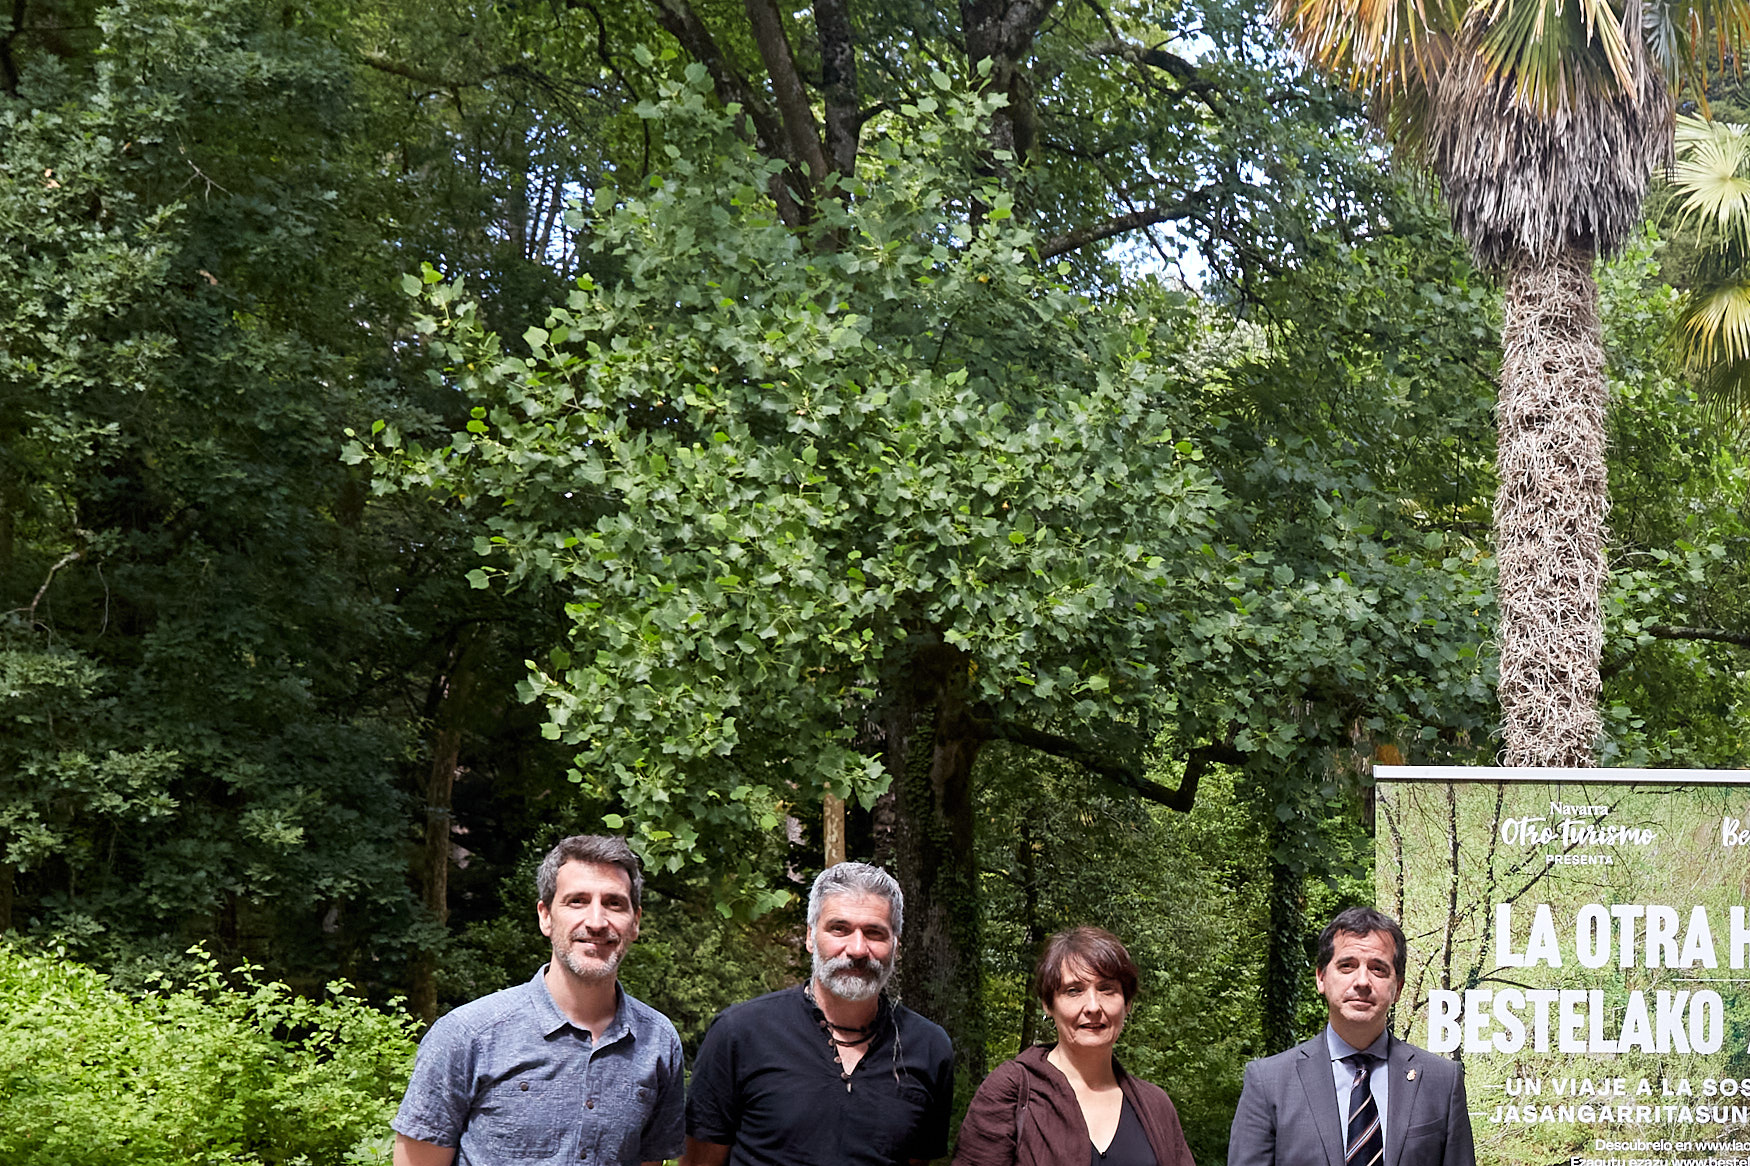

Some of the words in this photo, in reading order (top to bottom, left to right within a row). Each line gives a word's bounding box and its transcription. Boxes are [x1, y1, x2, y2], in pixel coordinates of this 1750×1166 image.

[1550, 801, 1609, 816] Navarra
[1501, 816, 1558, 846] Otro
[1545, 854, 1614, 865] PRESENTA
[1494, 902, 1562, 969] LA
[1576, 904, 1718, 970] OTRA
[1427, 988, 1725, 1056] BESTELAKO
[1505, 1077, 1541, 1097] UN
[1551, 1077, 1627, 1097] VIAJE
[1635, 1077, 1653, 1097] A
[1661, 1077, 1693, 1097] LA
[1595, 1137, 1672, 1151] Descúbrelo
[1675, 1141, 1693, 1151] en
